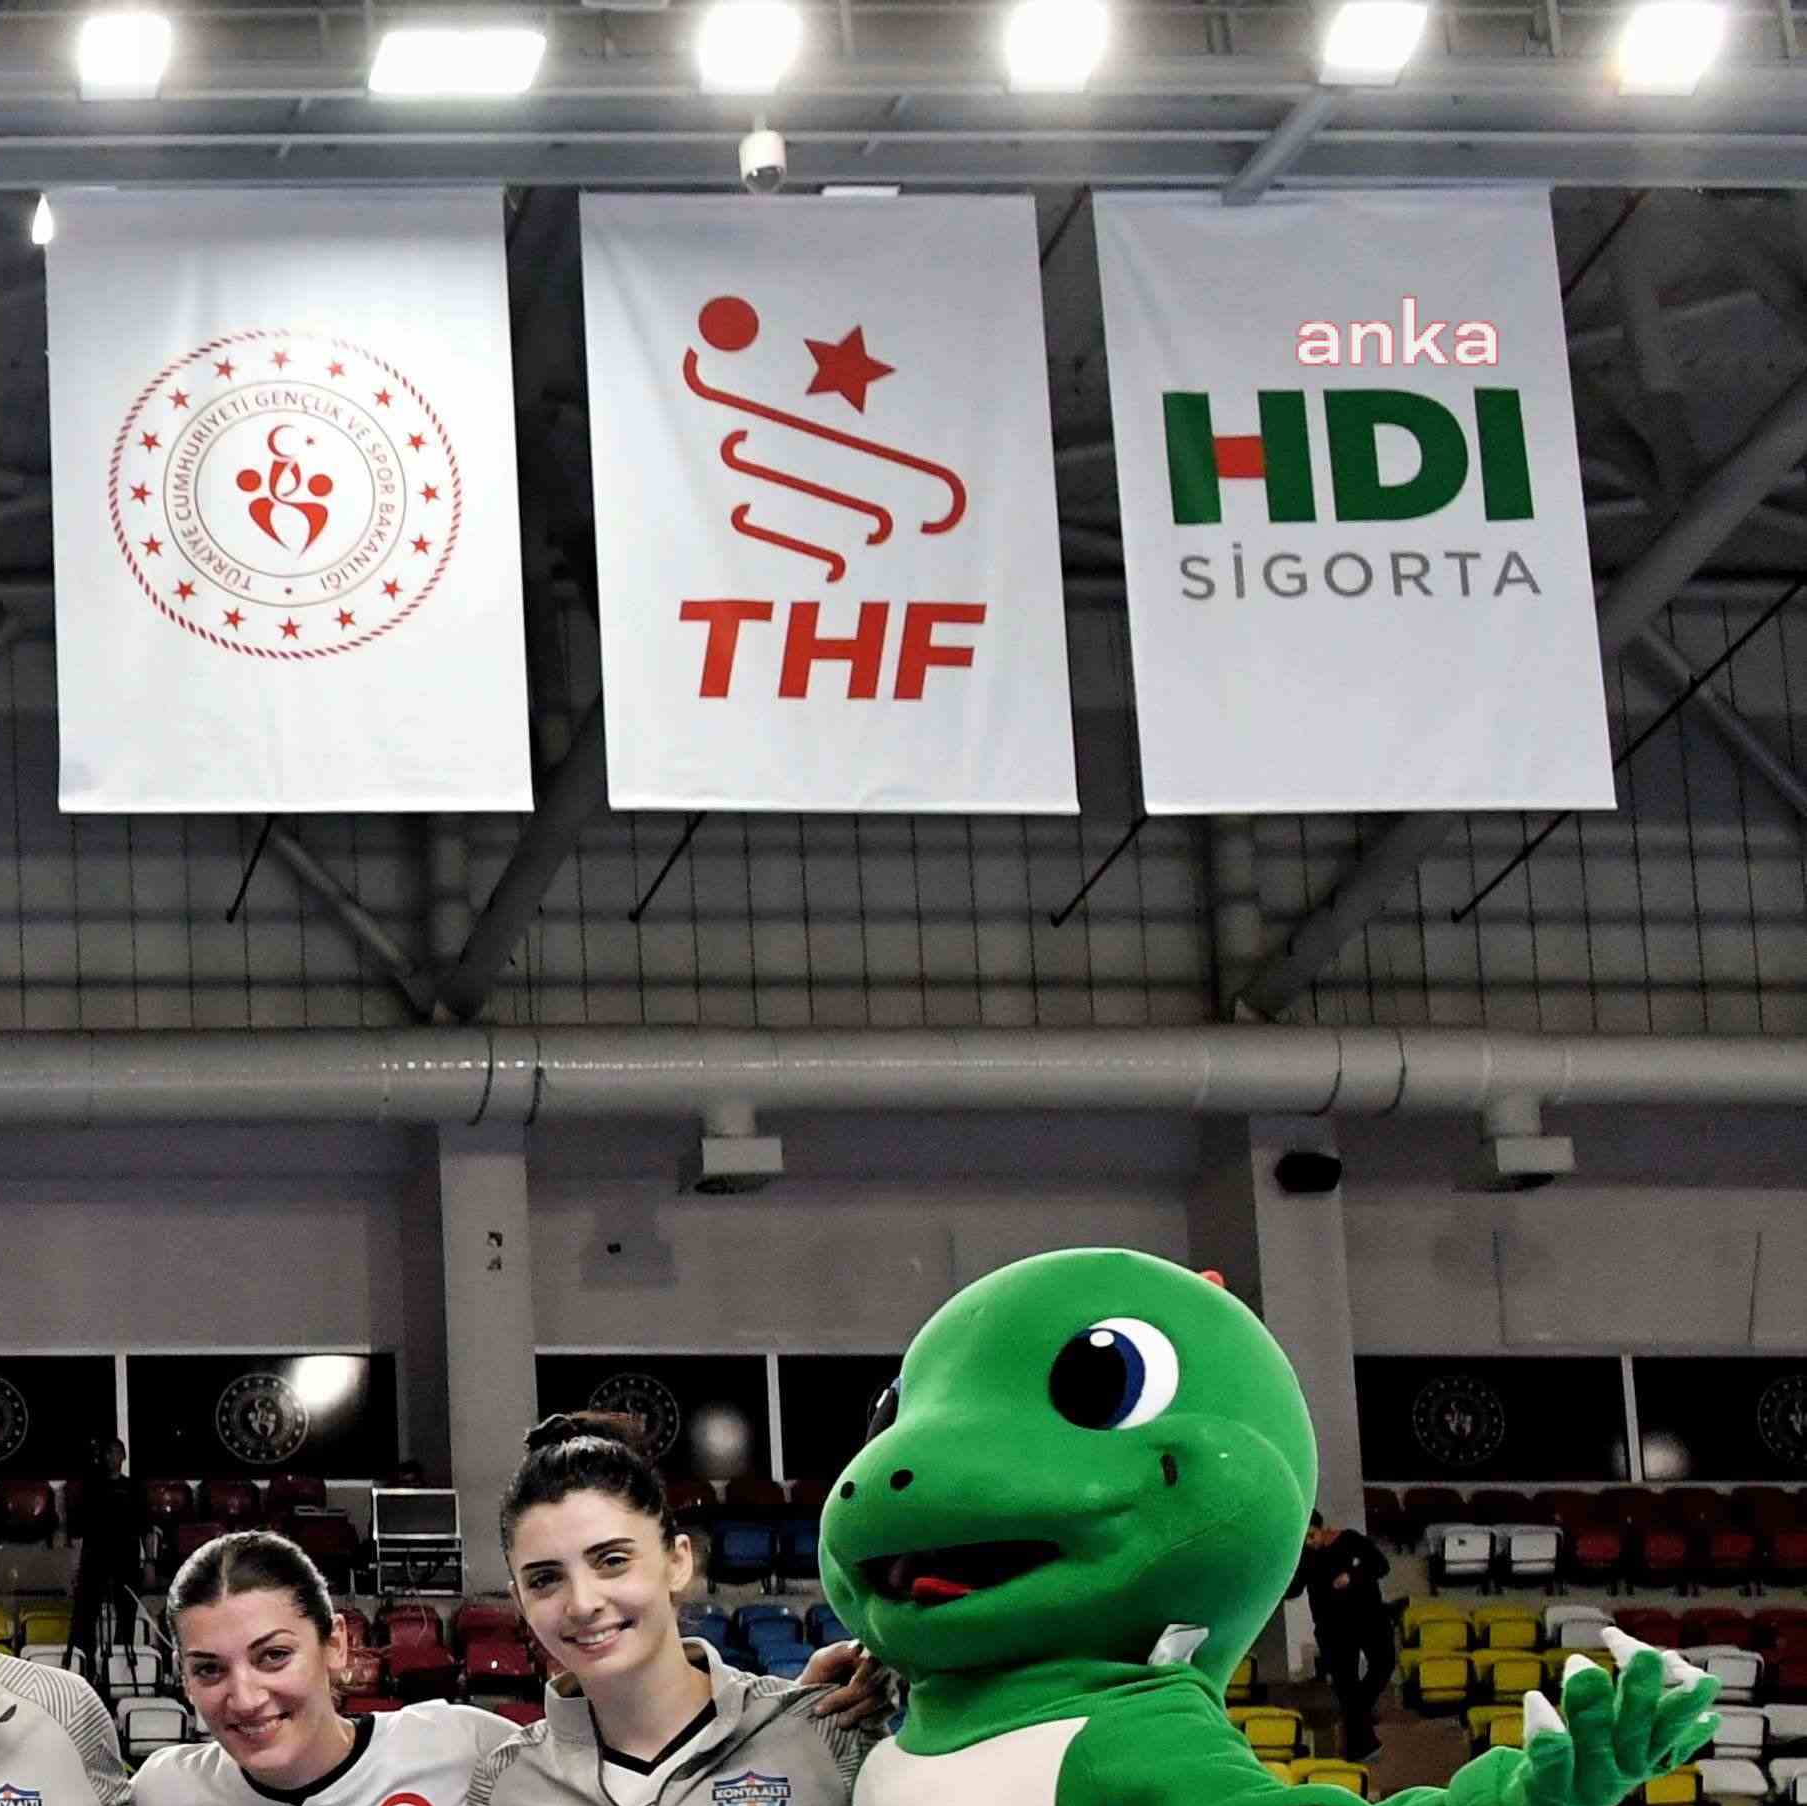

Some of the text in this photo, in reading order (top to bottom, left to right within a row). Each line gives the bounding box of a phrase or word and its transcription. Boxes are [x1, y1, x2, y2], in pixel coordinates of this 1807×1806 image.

[173, 397, 249, 521] CUMHURİYETİ
[368, 442, 395, 495] SPOR
[1162, 387, 1535, 525] HDI
[181, 524, 252, 591] TÜRKİYE
[1179, 543, 1542, 601] SİGORTA
[679, 601, 987, 700] THF
[715, 1785, 788, 1798] KONYAALTI
